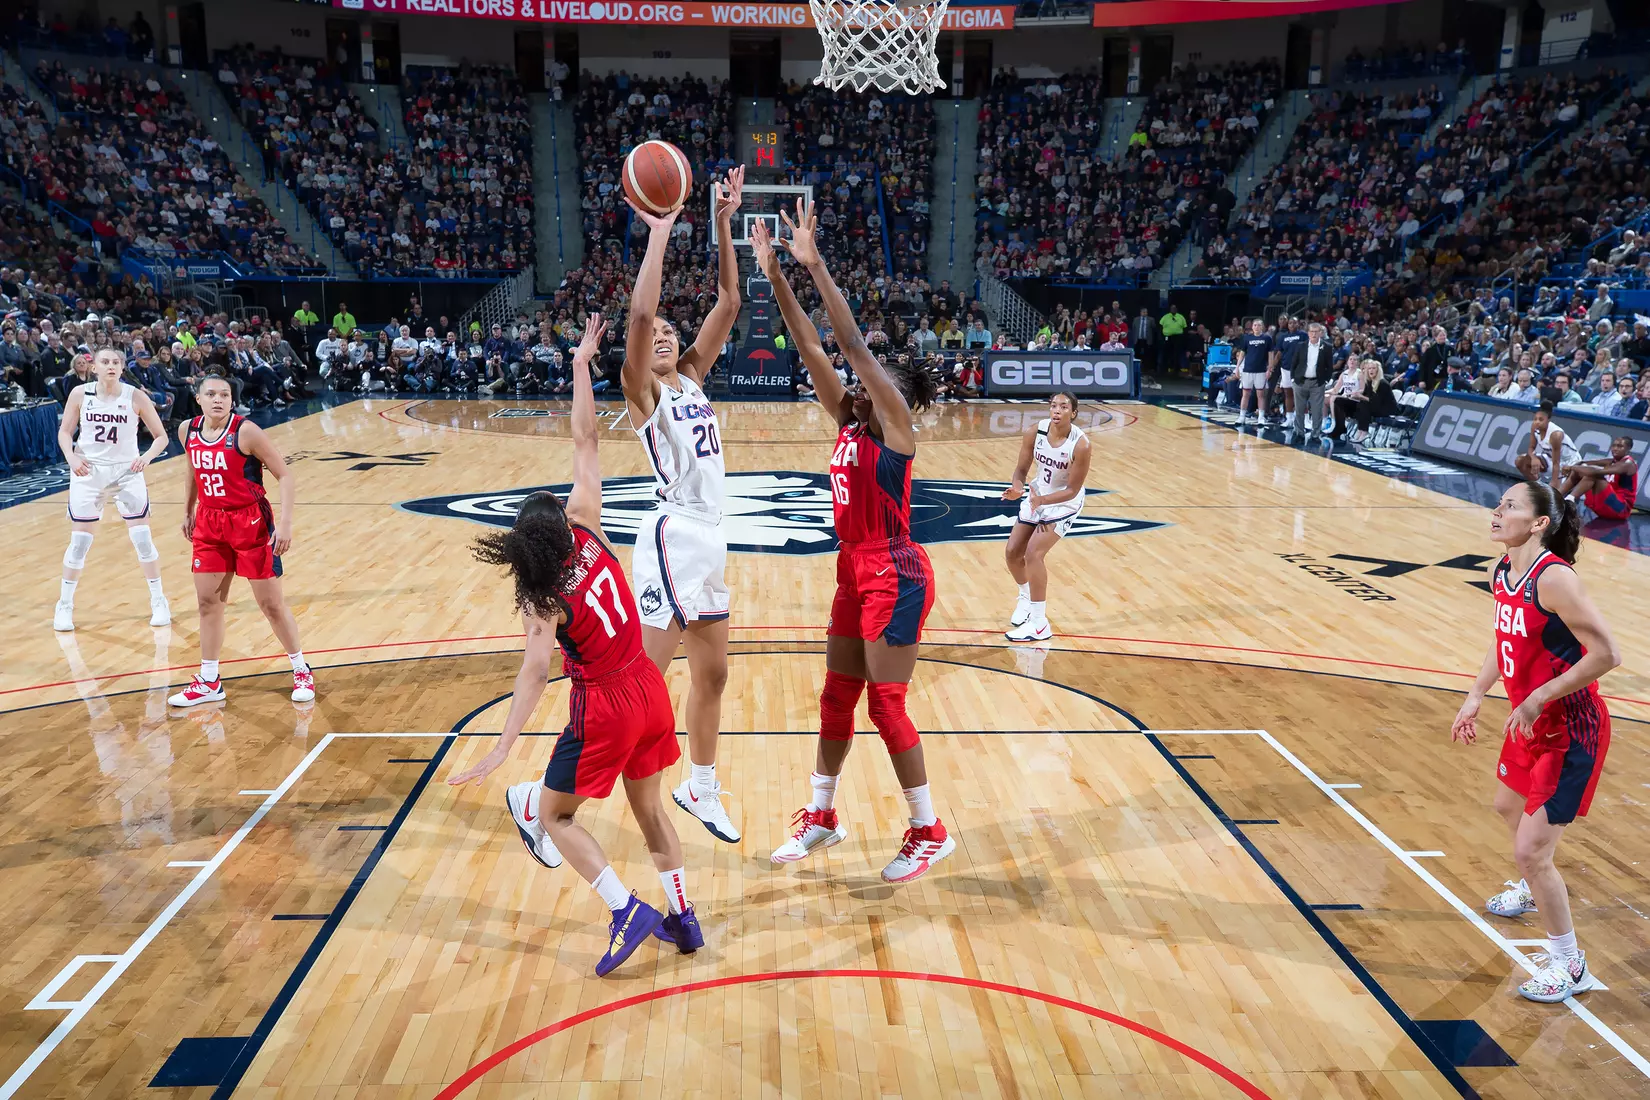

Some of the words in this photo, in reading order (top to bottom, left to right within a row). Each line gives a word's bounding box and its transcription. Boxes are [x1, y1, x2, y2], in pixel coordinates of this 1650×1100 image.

[406, 0, 515, 17] REALTORS
[521, 0, 535, 17] &
[540, 3, 683, 21] LIVELOUD.ORG
[711, 5, 806, 25] WORKING
[938, 9, 1005, 27] TIGMA
[1560, 11, 1577, 23] 112
[652, 50, 671, 59] 109
[752, 132, 777, 145] 4:13
[756, 147, 775, 167] 14
[731, 375, 791, 386] TRAVELERS
[991, 360, 1128, 386] GEICO
[86, 413, 128, 424] UCONN
[94, 425, 118, 444] 24
[692, 423, 720, 458] 20
[191, 449, 228, 470] USA
[1035, 452, 1069, 470] UCONN
[200, 473, 226, 497] 32
[1043, 468, 1052, 484] 3
[830, 472, 850, 505] 16
[1272, 552, 1316, 563] XL
[1298, 564, 1397, 602] CENTER
[585, 566, 629, 639] 17
[1494, 600, 1528, 638] USA
[1501, 640, 1515, 678] 6
